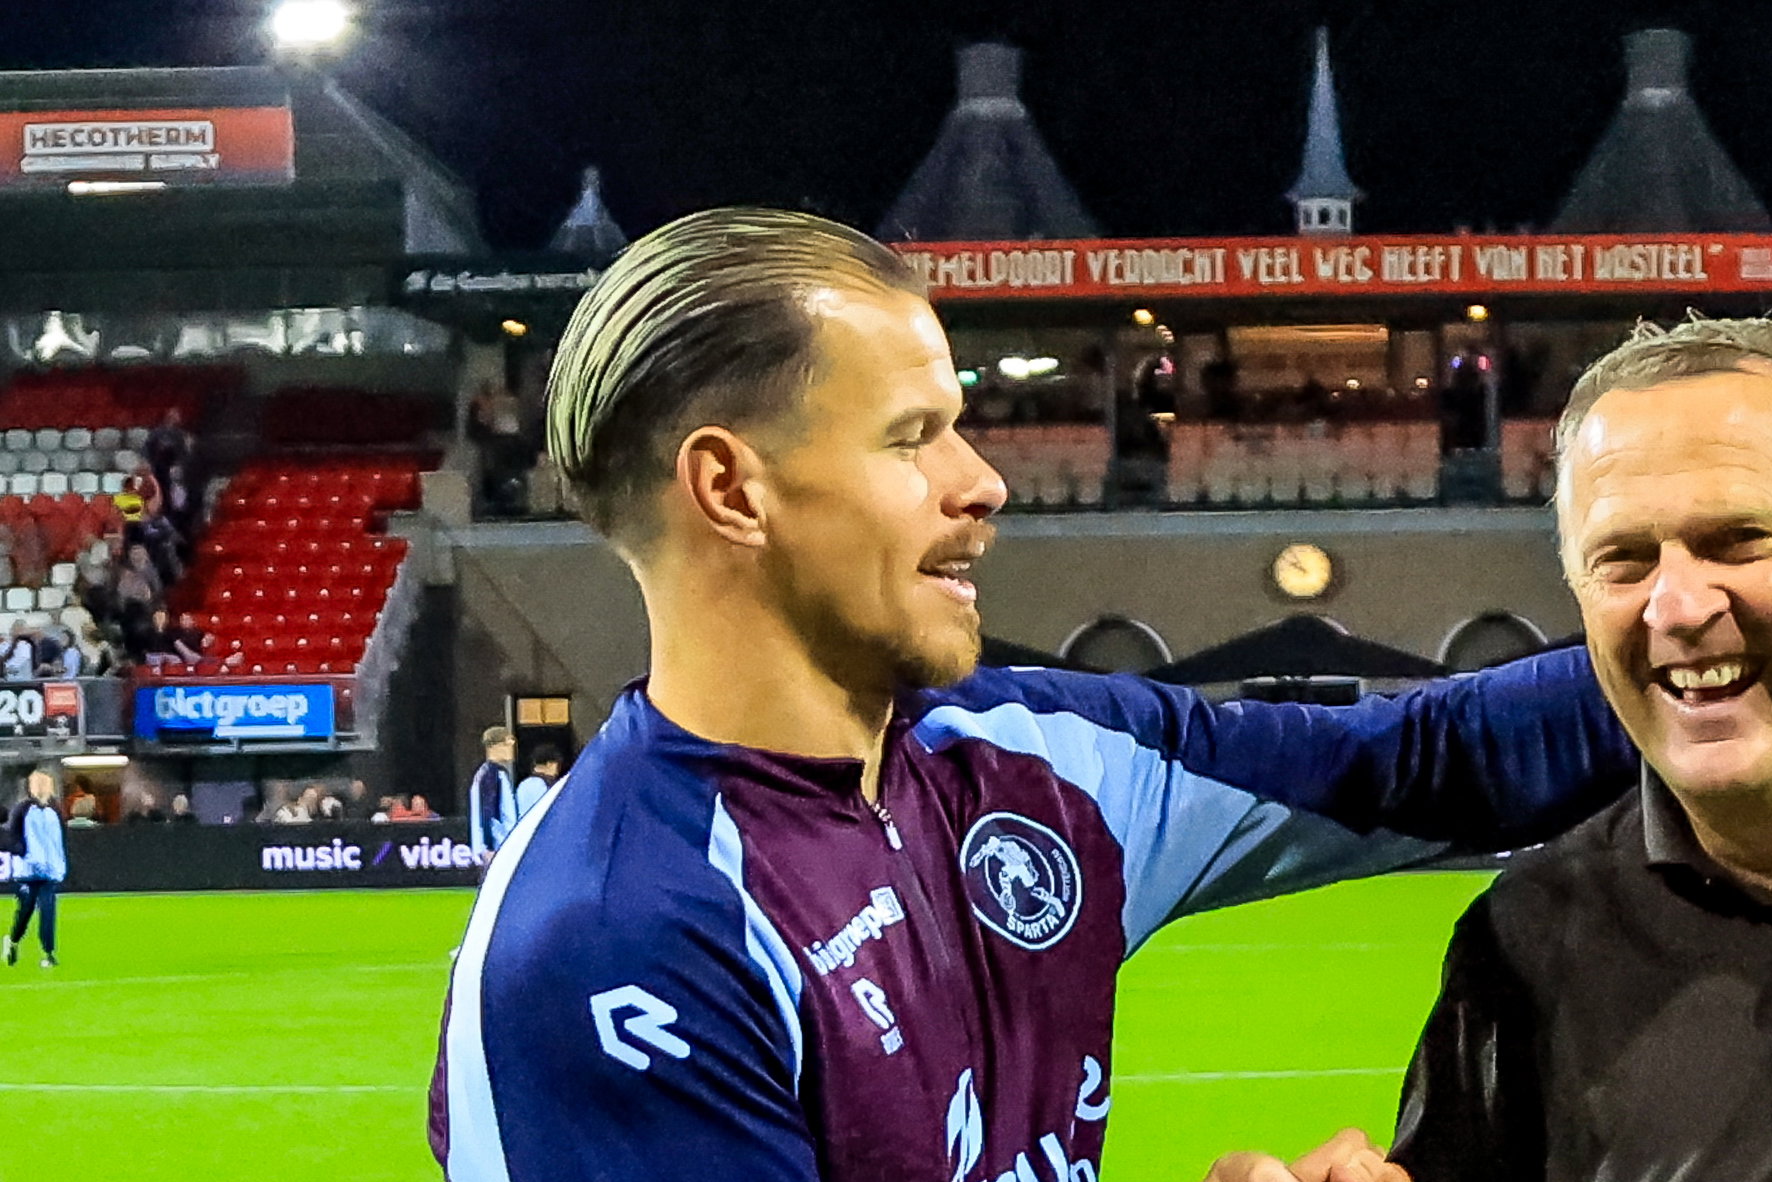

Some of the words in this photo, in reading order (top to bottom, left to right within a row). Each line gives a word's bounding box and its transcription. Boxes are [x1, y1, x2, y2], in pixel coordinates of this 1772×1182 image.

[31, 127, 207, 149] HECOTHERM
[1236, 247, 1306, 284] VEEL
[1313, 245, 1374, 282] WEG
[1380, 245, 1463, 282] HEEFT
[0, 689, 44, 726] 20
[261, 837, 362, 871] music
[1006, 913, 1060, 940] SPARTA
